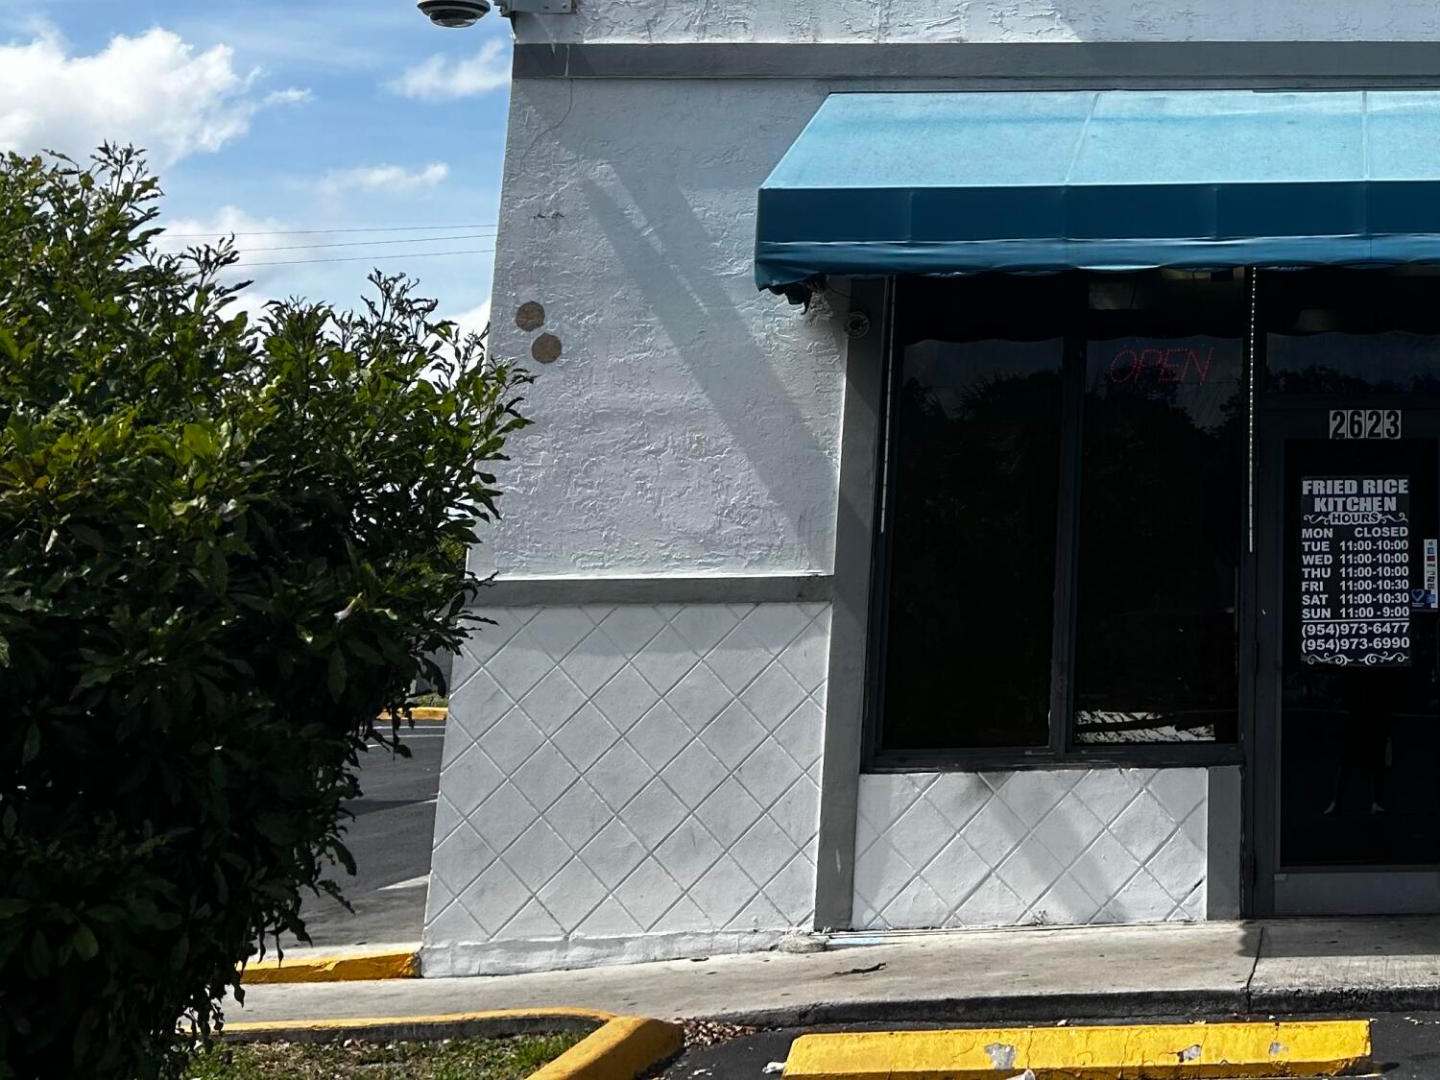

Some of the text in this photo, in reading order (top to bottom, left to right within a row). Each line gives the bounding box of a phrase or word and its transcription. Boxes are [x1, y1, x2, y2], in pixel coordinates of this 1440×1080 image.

[1110, 347, 1214, 384] OPEN
[1331, 411, 1400, 439] 2623
[1302, 479, 1409, 495] FRIED RICE
[1314, 497, 1397, 512] KITCHEN
[1331, 512, 1380, 524] HOURS
[1302, 527, 1408, 539] MON CLOSED
[1302, 540, 1408, 552] TUE 11:00-10:00
[1302, 553, 1409, 565] WED 11:00-10:00
[1302, 567, 1409, 579] THU 11:00-10:00
[1302, 580, 1409, 592] FRI 11:00-10:30
[1302, 593, 1409, 605] SAT 11:00-10:30
[1302, 608, 1331, 619] SUN
[1301, 623, 1409, 638] (954)973-6477
[1301, 637, 1410, 653] (954)973-6990
